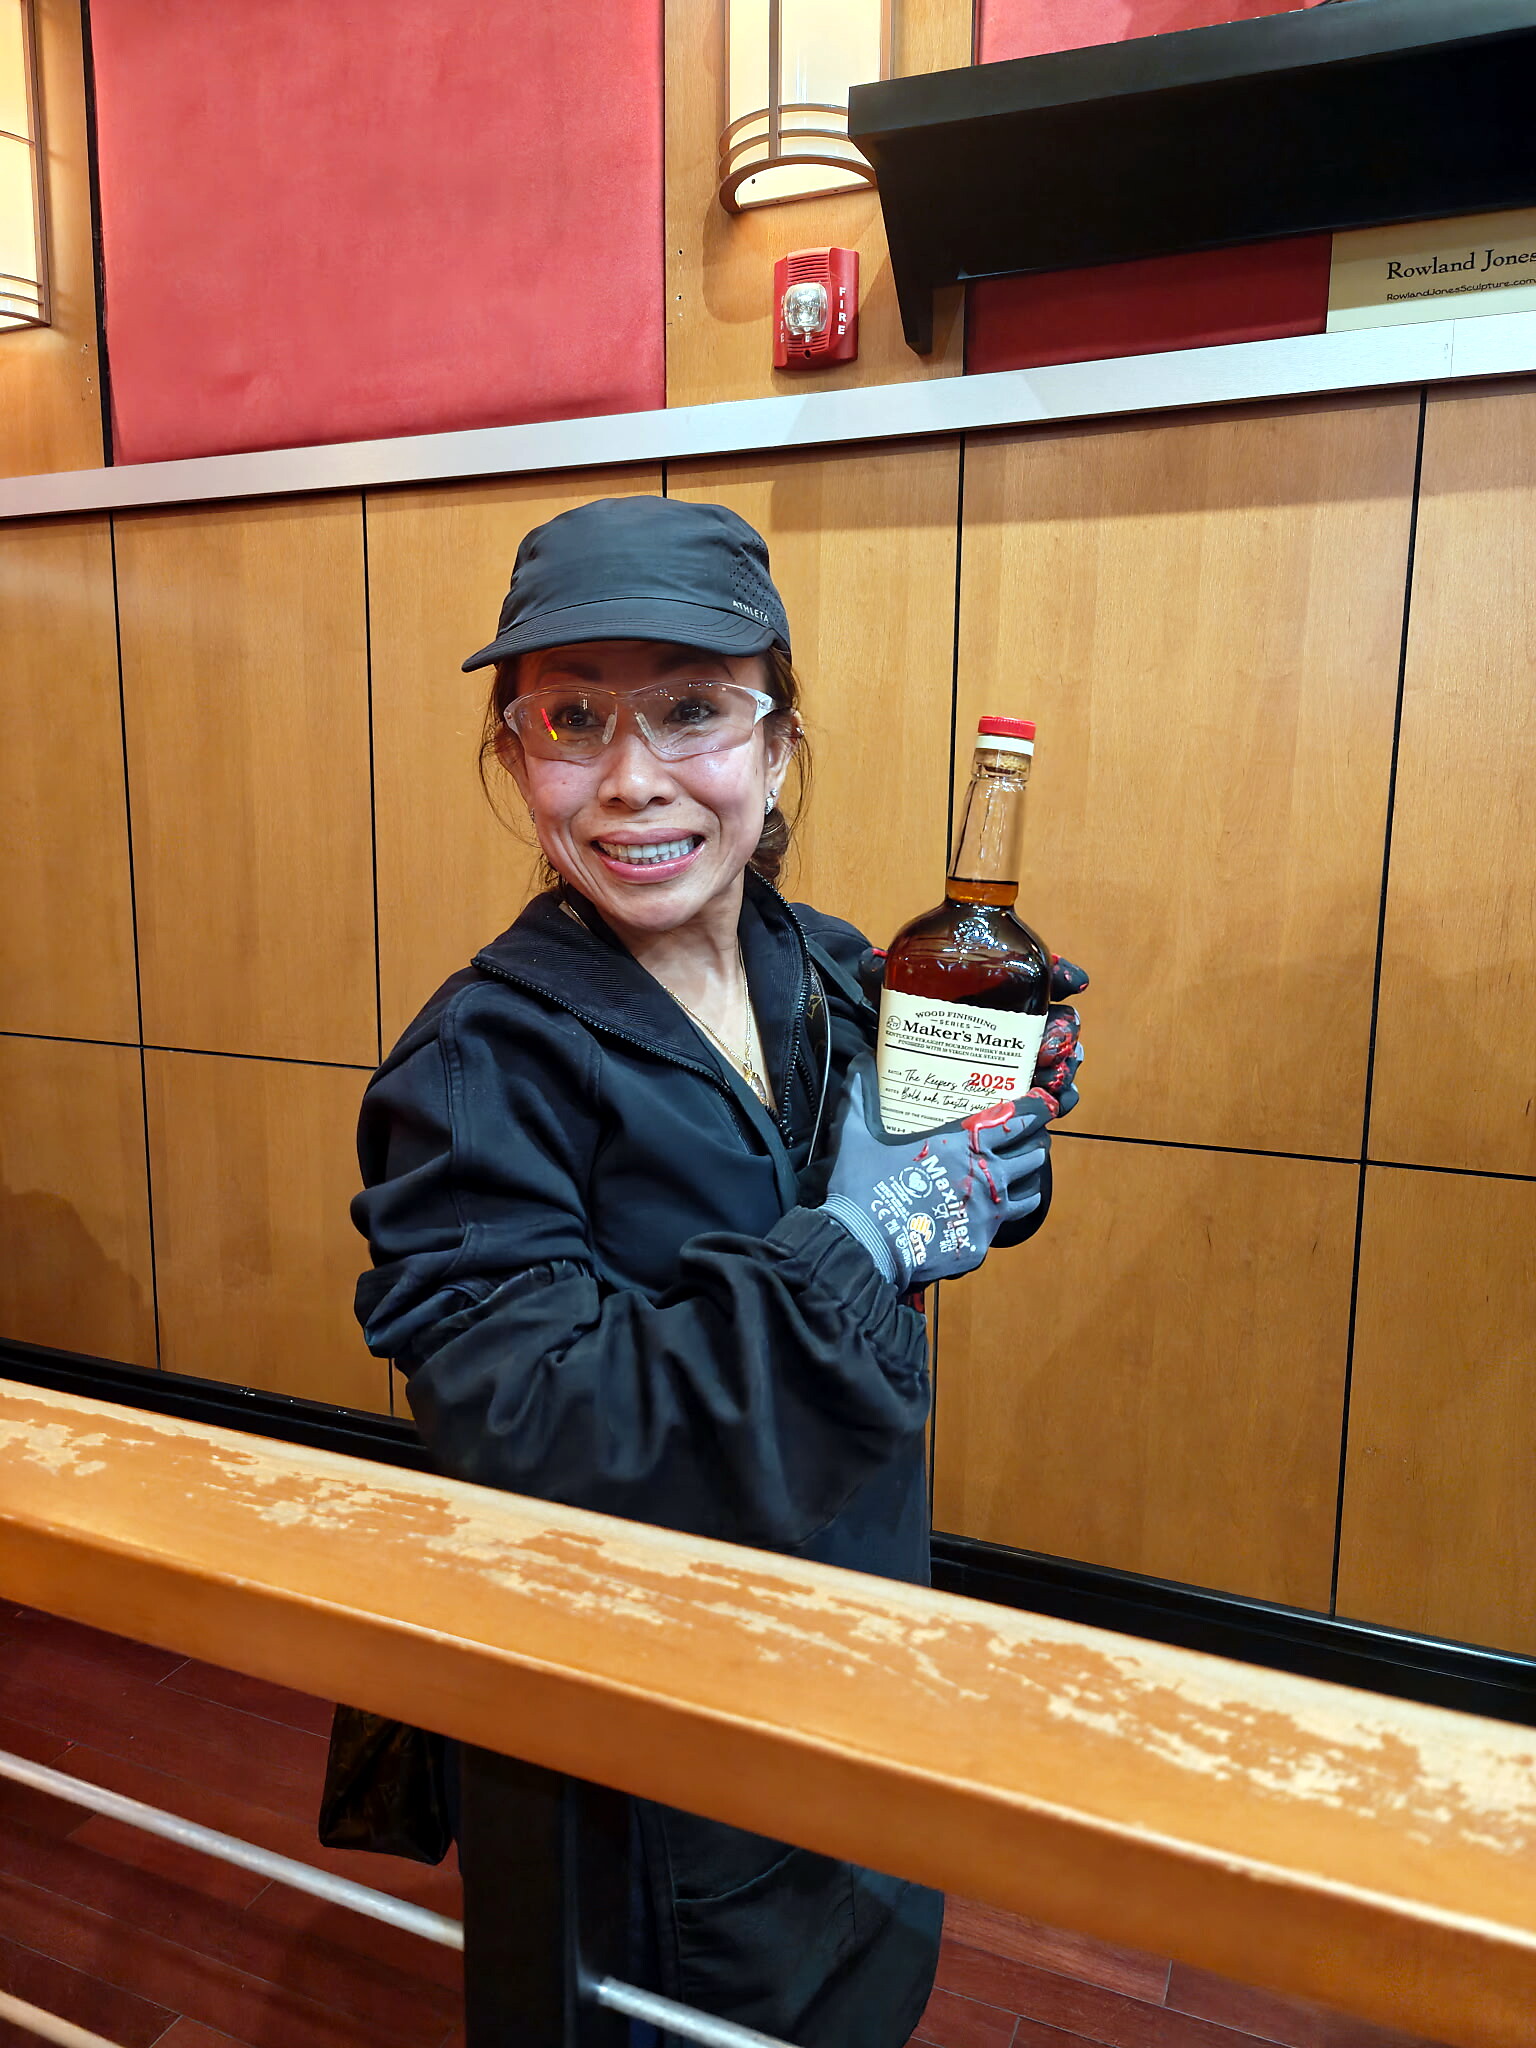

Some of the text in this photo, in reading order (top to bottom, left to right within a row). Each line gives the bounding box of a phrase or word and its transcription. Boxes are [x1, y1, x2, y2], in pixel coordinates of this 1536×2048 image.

[1386, 249, 1536, 280] Rowland Jones
[838, 286, 847, 335] FIRE
[732, 600, 769, 624] ATHLETA
[915, 1010, 997, 1031] WOOD FINISHING
[939, 1019, 971, 1029] SERIES
[902, 1019, 972, 1043] Maker's
[974, 1032, 1026, 1050] Mark
[904, 1068, 921, 1082] The
[923, 1072, 957, 1091] Keepers
[969, 1072, 1017, 1091] 2025
